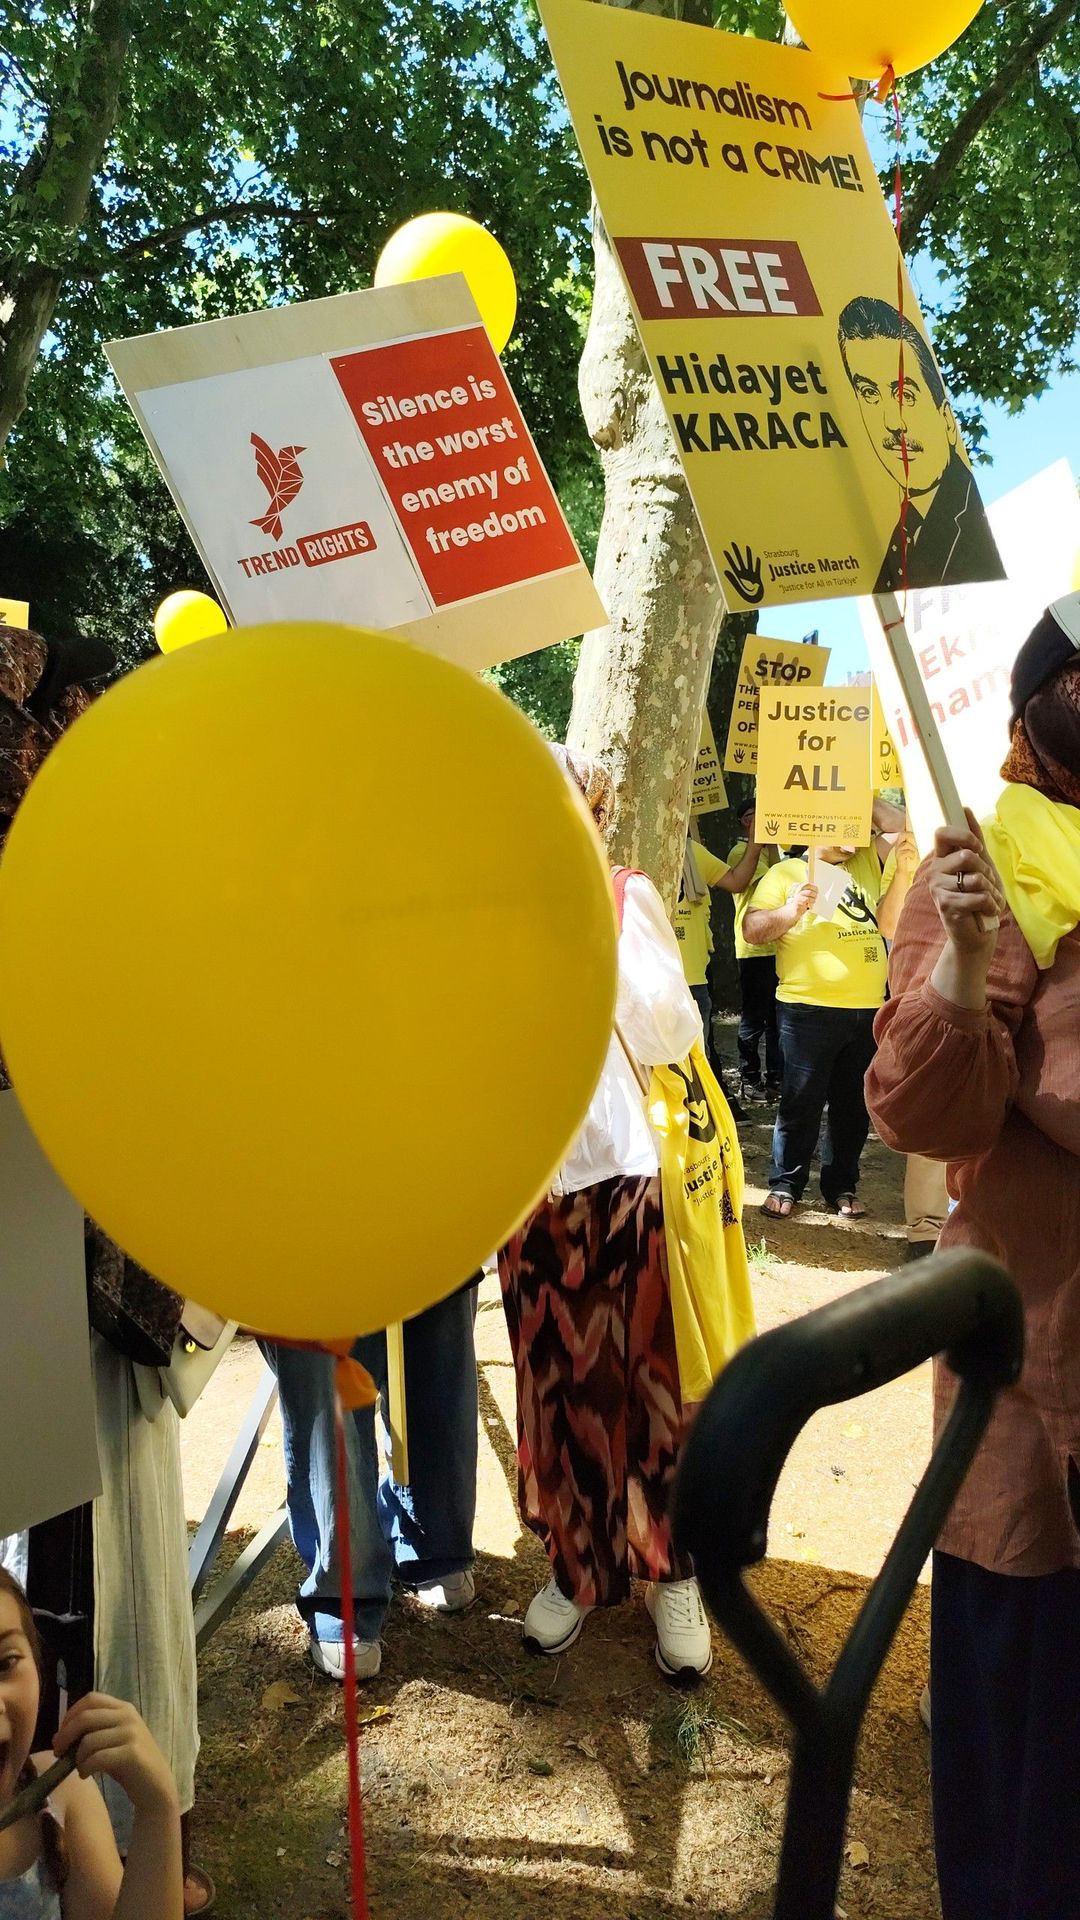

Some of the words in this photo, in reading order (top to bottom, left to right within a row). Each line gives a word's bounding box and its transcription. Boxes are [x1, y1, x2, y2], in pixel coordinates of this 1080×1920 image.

[615, 61, 812, 130] Journalism
[594, 114, 633, 157] is
[641, 129, 709, 167] not
[721, 143, 748, 173] a
[754, 141, 864, 192] CRIME!
[641, 242, 798, 314] FREE
[656, 353, 828, 405] Hidayet
[361, 386, 469, 426] Silence
[467, 375, 497, 402] is
[382, 441, 435, 468] the
[435, 416, 518, 455] worst
[672, 411, 848, 453] KARACA
[401, 470, 499, 513] enemy
[503, 456, 531, 486] of
[425, 505, 547, 554] freedom
[237, 546, 301, 578] TREND
[303, 527, 369, 561] RIGHTS
[763, 549, 800, 559] Strasbourg
[768, 560, 817, 582] Justice
[817, 555, 860, 573] March
[804, 580, 816, 590] for
[755, 658, 812, 683] STOP
[738, 684, 760, 696] THE
[767, 699, 870, 722] Justice
[797, 729, 837, 751] for
[783, 764, 846, 791] ALL
[787, 822, 837, 833] ECHR
[837, 929, 867, 939] Justice
